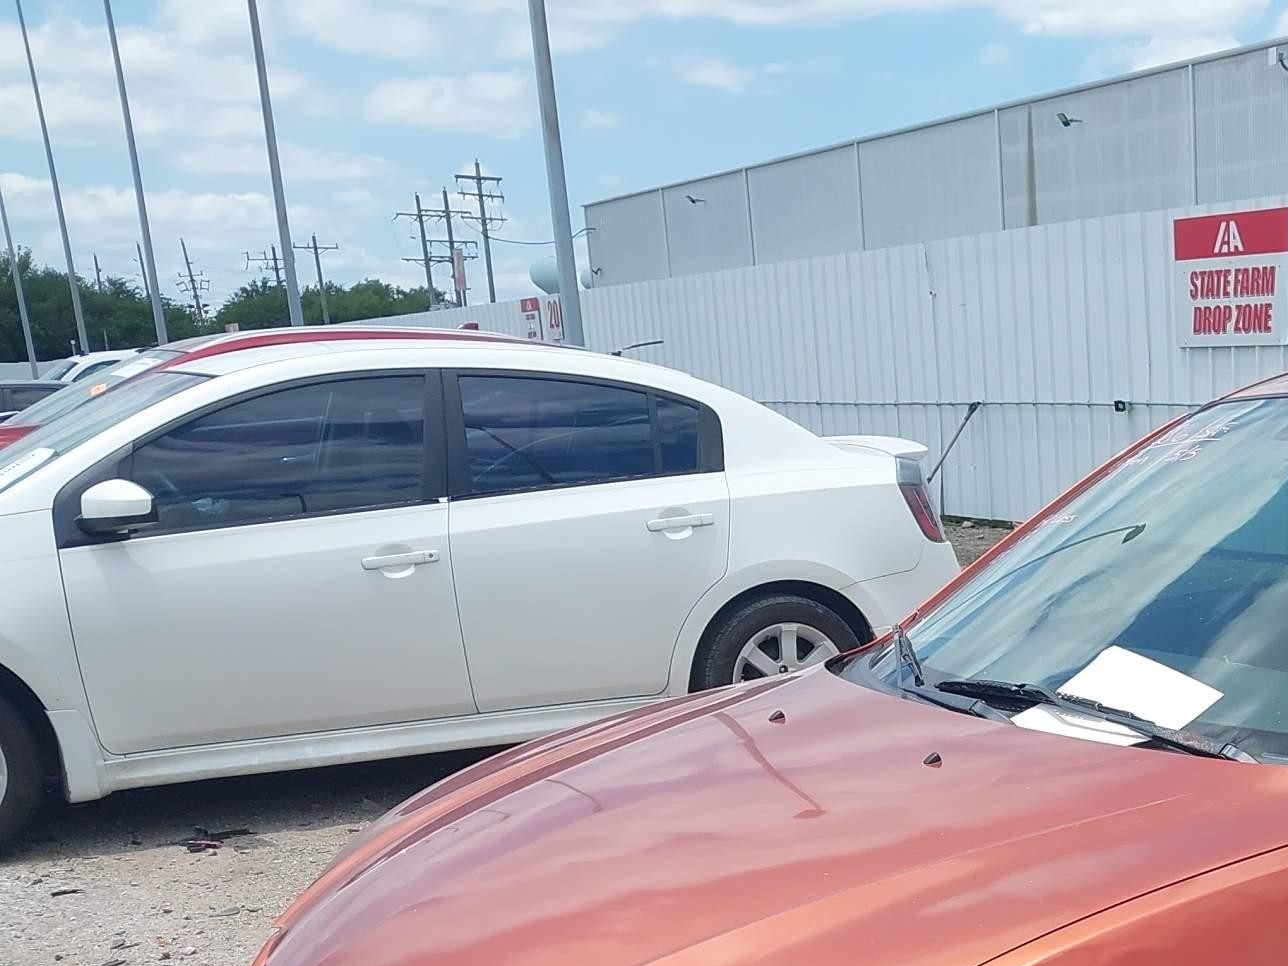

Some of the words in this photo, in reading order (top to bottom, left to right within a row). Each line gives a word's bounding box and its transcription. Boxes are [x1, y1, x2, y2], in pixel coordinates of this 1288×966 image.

[1190, 269, 1232, 301] STATE
[1233, 266, 1276, 298] FARM
[1193, 305, 1232, 335] DROP
[1233, 303, 1273, 334] ZONE
